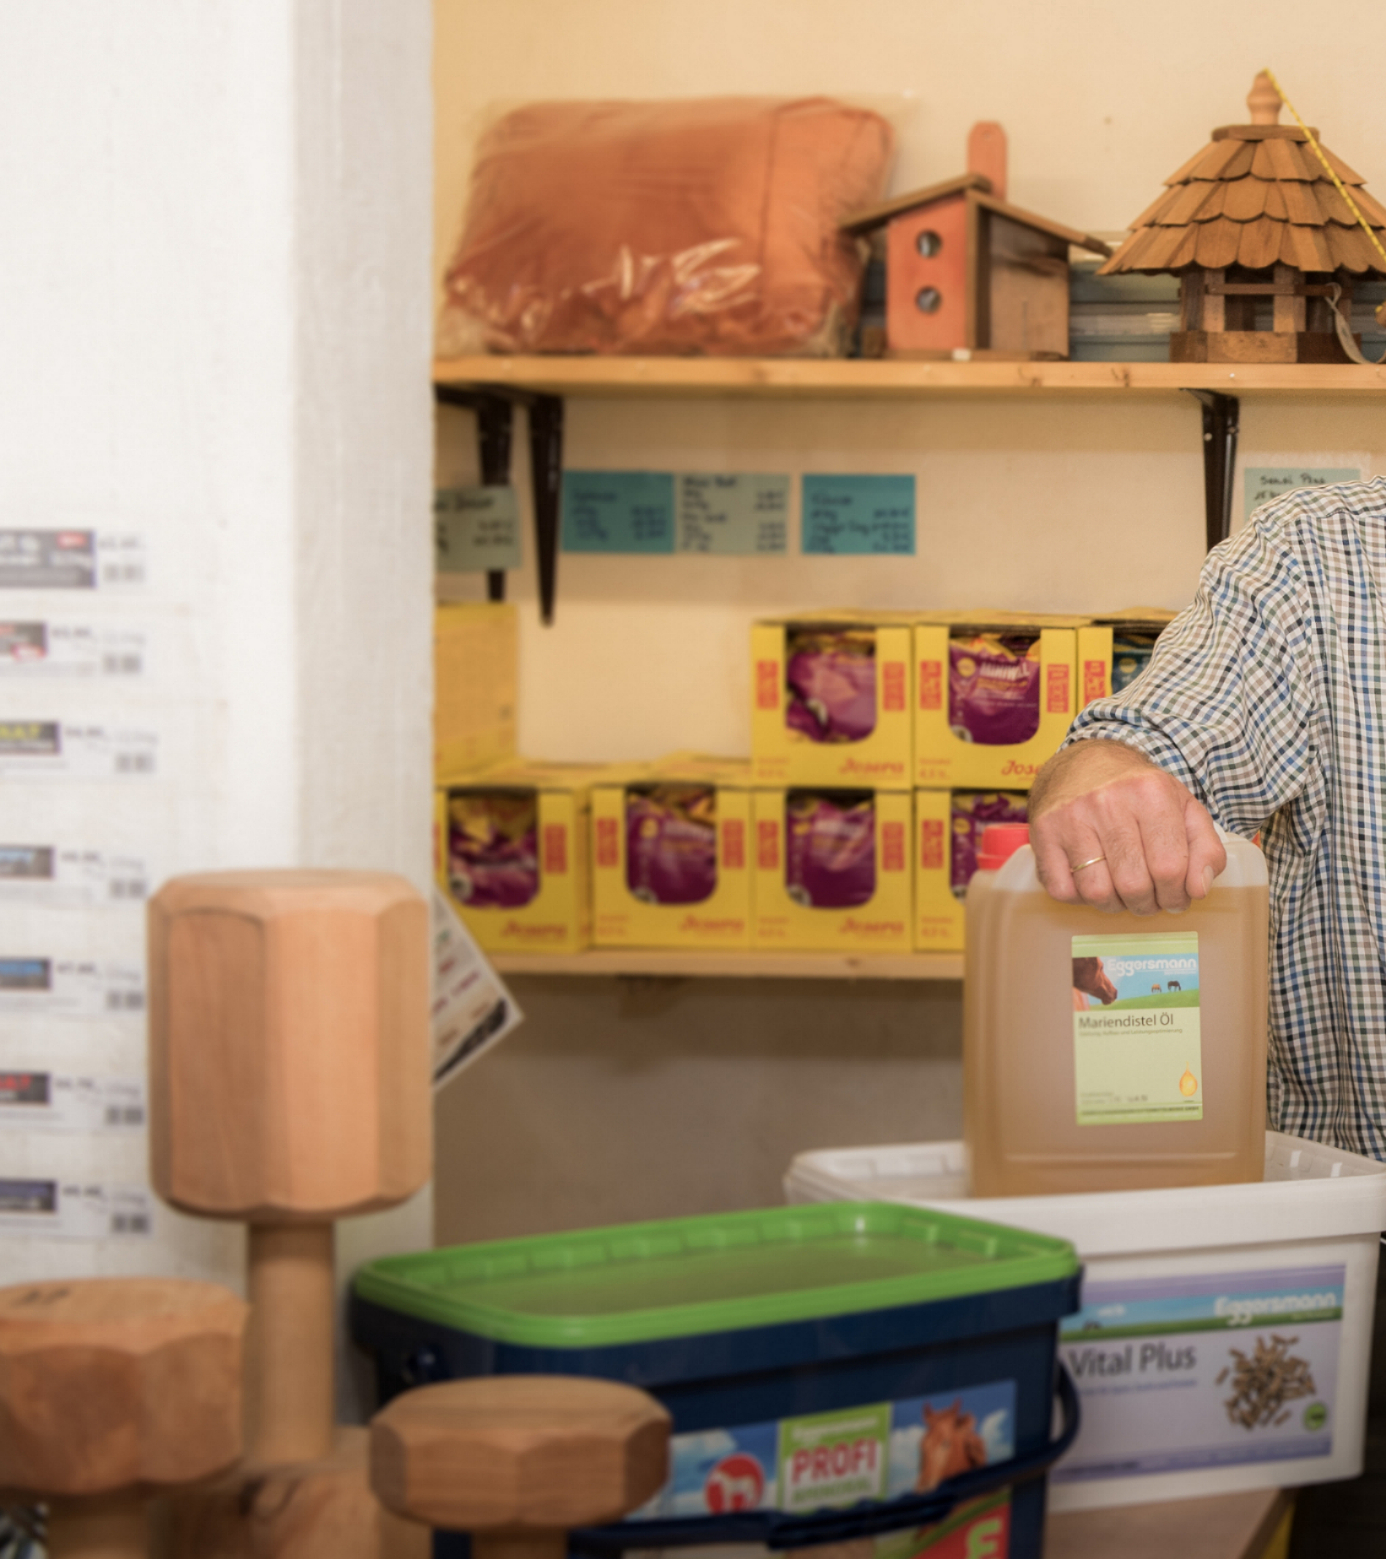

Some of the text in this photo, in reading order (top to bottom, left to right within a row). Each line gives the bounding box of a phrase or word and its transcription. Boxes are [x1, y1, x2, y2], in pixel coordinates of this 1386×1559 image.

[1106, 958, 1197, 977] Eggersmann
[1078, 1012, 1174, 1029] Mariendistel Öl
[1213, 1292, 1337, 1327] Eggersmann
[1066, 1342, 1198, 1378] Vital Plus
[791, 1438, 877, 1485] PROFI
